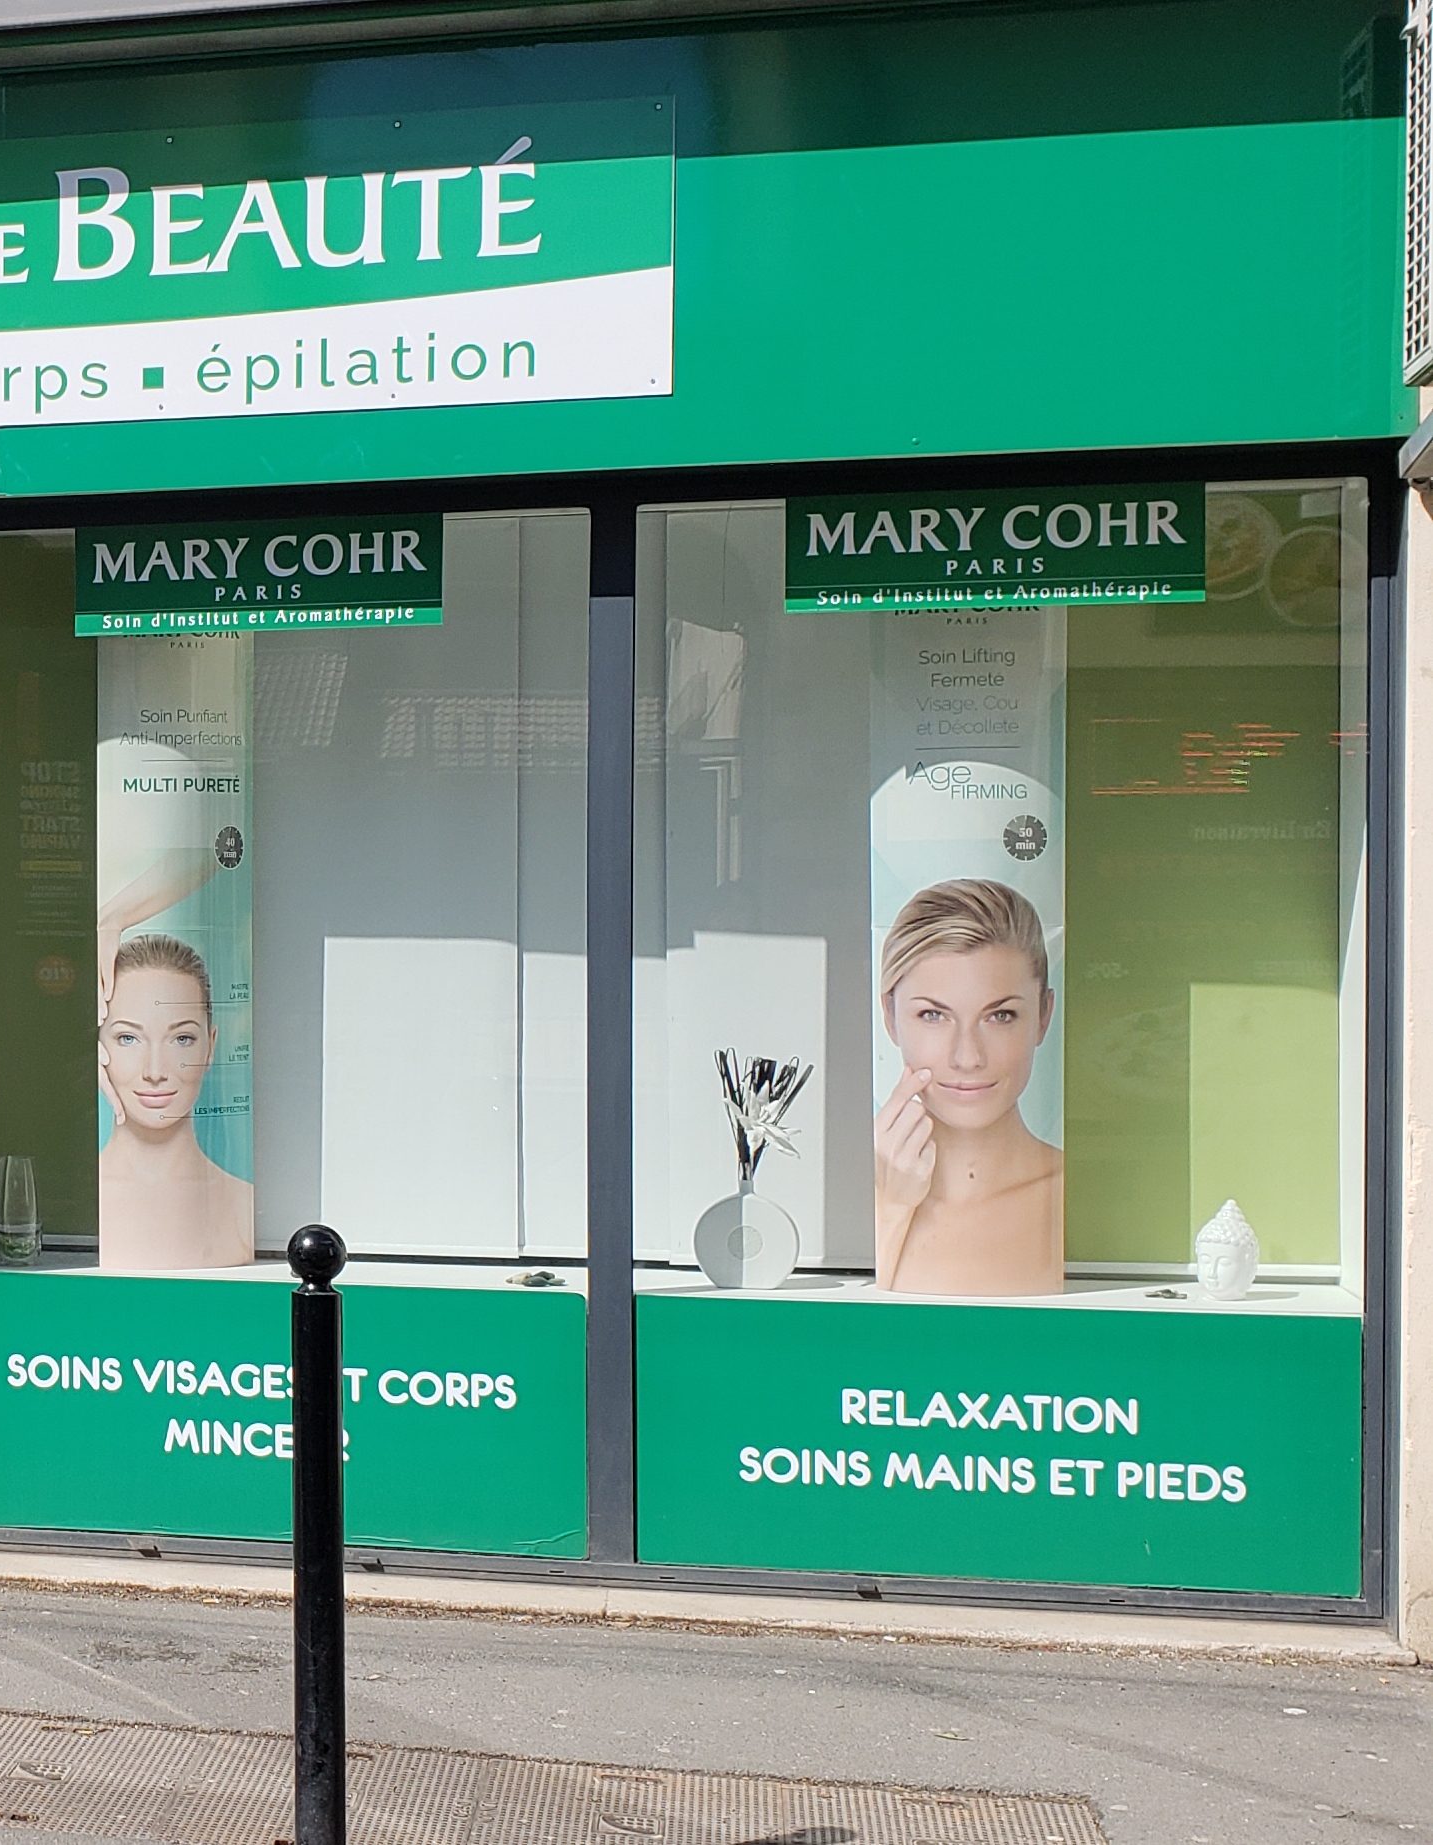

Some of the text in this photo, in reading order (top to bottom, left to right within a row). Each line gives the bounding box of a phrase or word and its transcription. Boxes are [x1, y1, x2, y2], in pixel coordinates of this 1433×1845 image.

[53, 136, 543, 283] BEAUTÉ
[197, 332, 537, 406] épilation
[806, 499, 1187, 557] MARY COHR
[92, 530, 427, 584] MARY COHR
[946, 557, 1045, 576] PARIS
[215, 584, 302, 602] PARIS
[816, 580, 1172, 606] Soin d'Institut et Aromathérapie
[102, 606, 415, 630] Soin d'Institut et Aromathérapie
[947, 617, 988, 625] PARIS
[170, 641, 205, 649] PARIS
[918, 648, 1015, 667] Soin Lifting
[983, 695, 1018, 710] Cou
[140, 708, 228, 724] Soin Purifiant
[917, 721, 933, 736] et
[119, 730, 242, 748] Anti-Imperfections
[123, 774, 241, 793] MULTI PURETÉ
[909, 761, 972, 791] Age
[951, 783, 1028, 800] FIRMING
[1018, 827, 1033, 838] 50
[1015, 839, 1036, 850] min
[7, 1353, 123, 1391] SOINS
[377, 1369, 517, 1410] CORPS
[841, 1388, 1138, 1436] RELAXATION
[738, 1446, 1248, 1503] SOINS MAINS ET PIEDS
